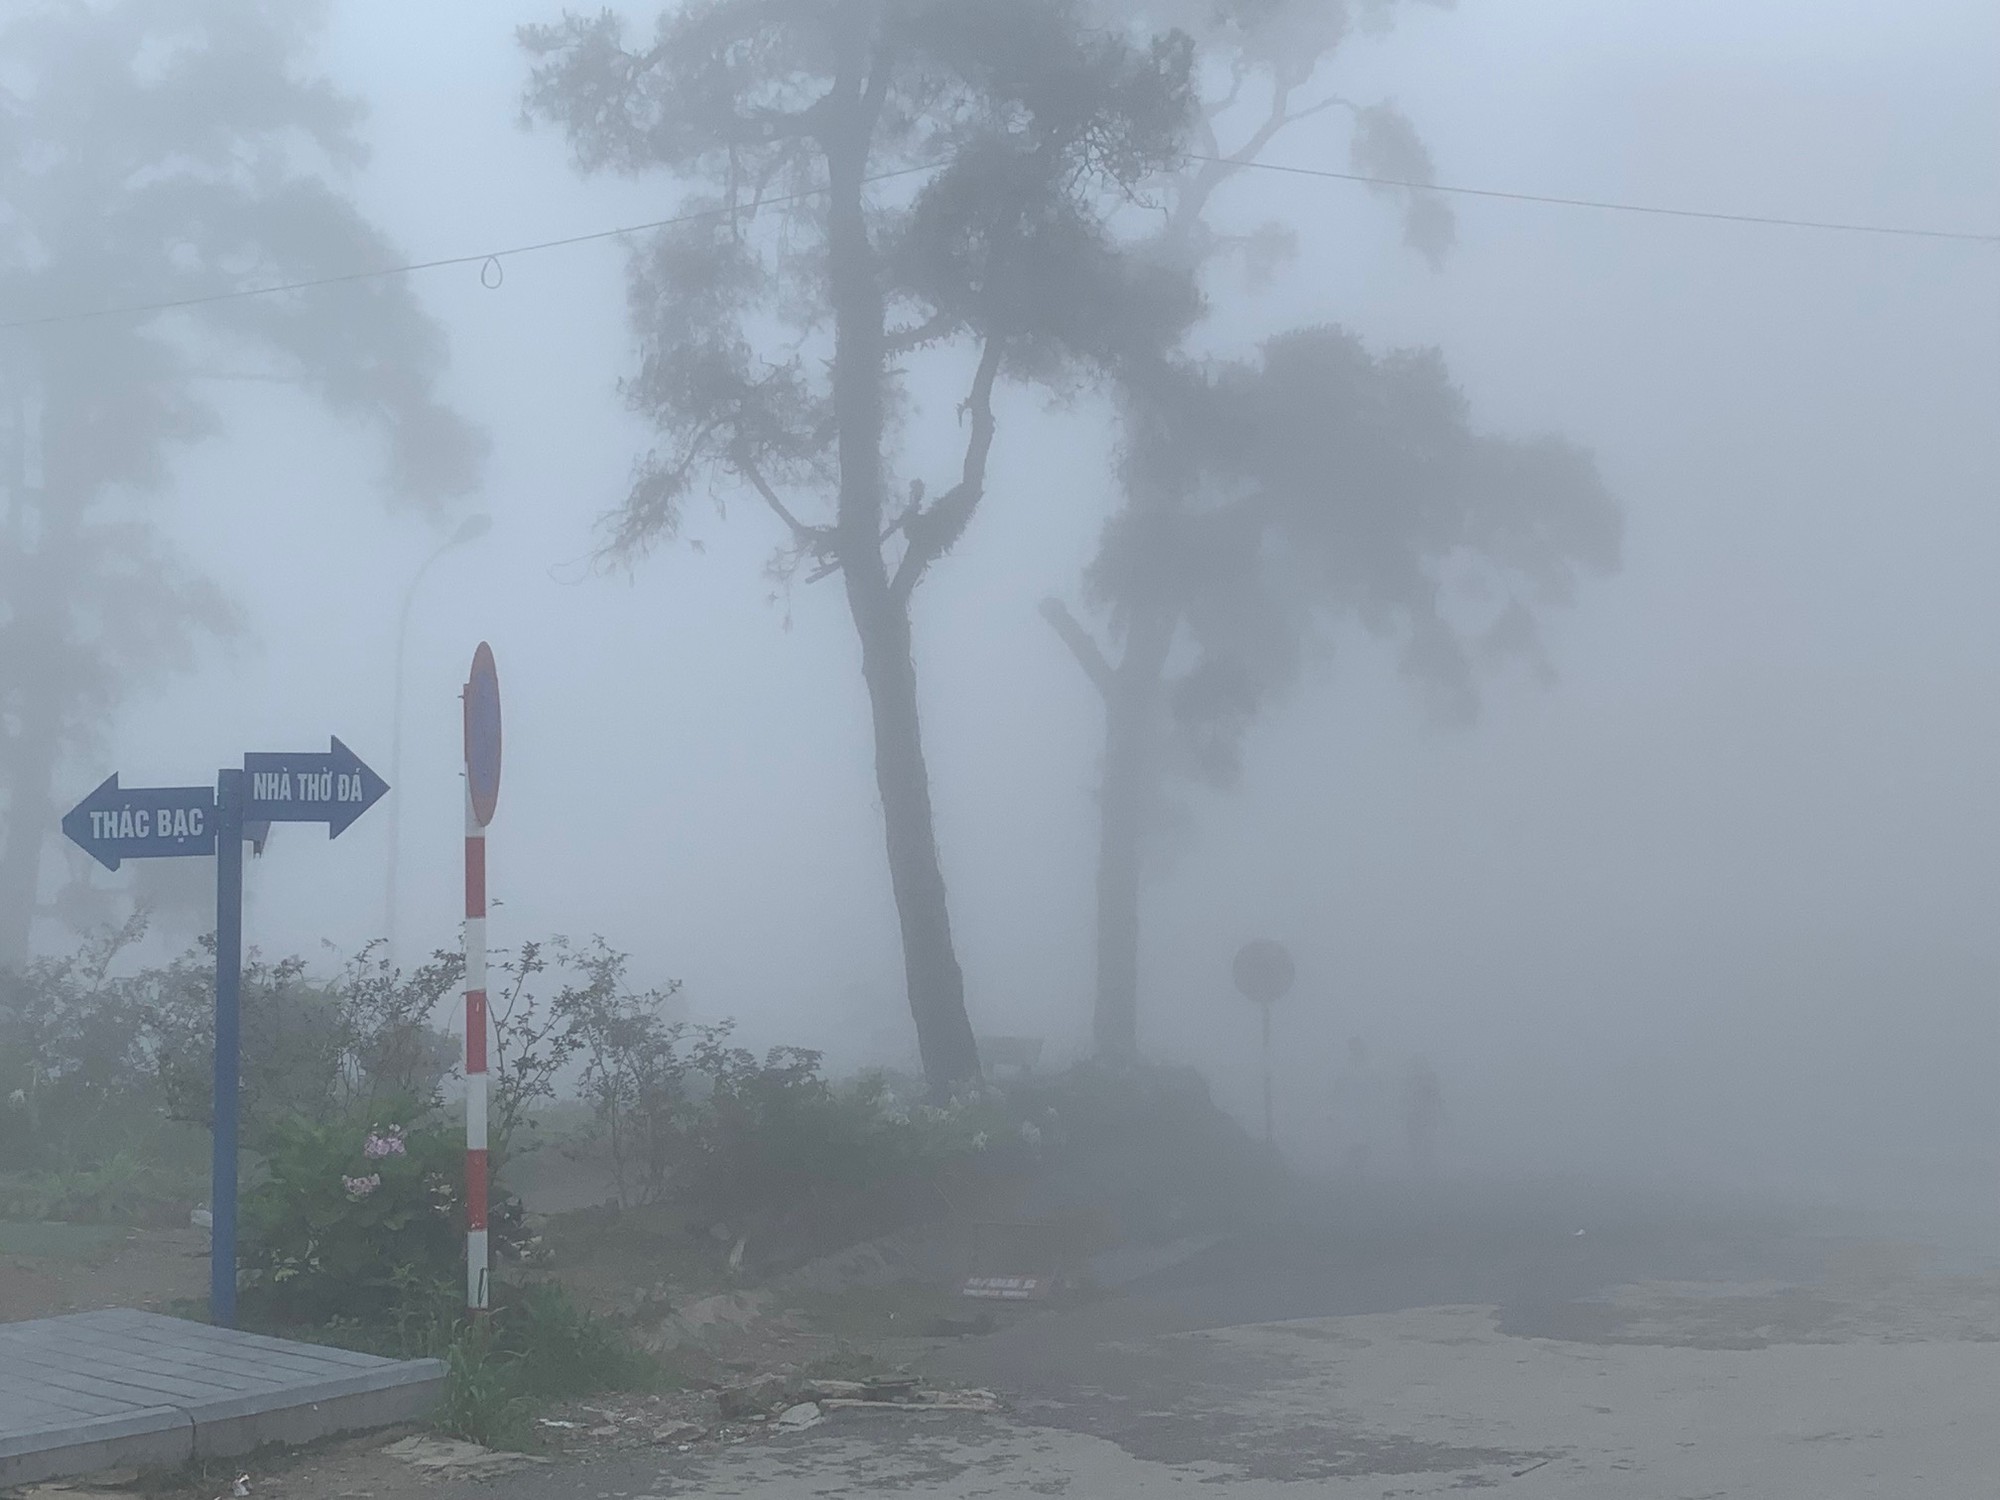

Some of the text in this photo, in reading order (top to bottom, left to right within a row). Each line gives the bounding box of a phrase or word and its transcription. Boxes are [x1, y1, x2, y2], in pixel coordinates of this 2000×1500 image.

[253, 766, 362, 802] NHÀ THỜ ĐÁ
[90, 804, 203, 842] THÁC BẠC
